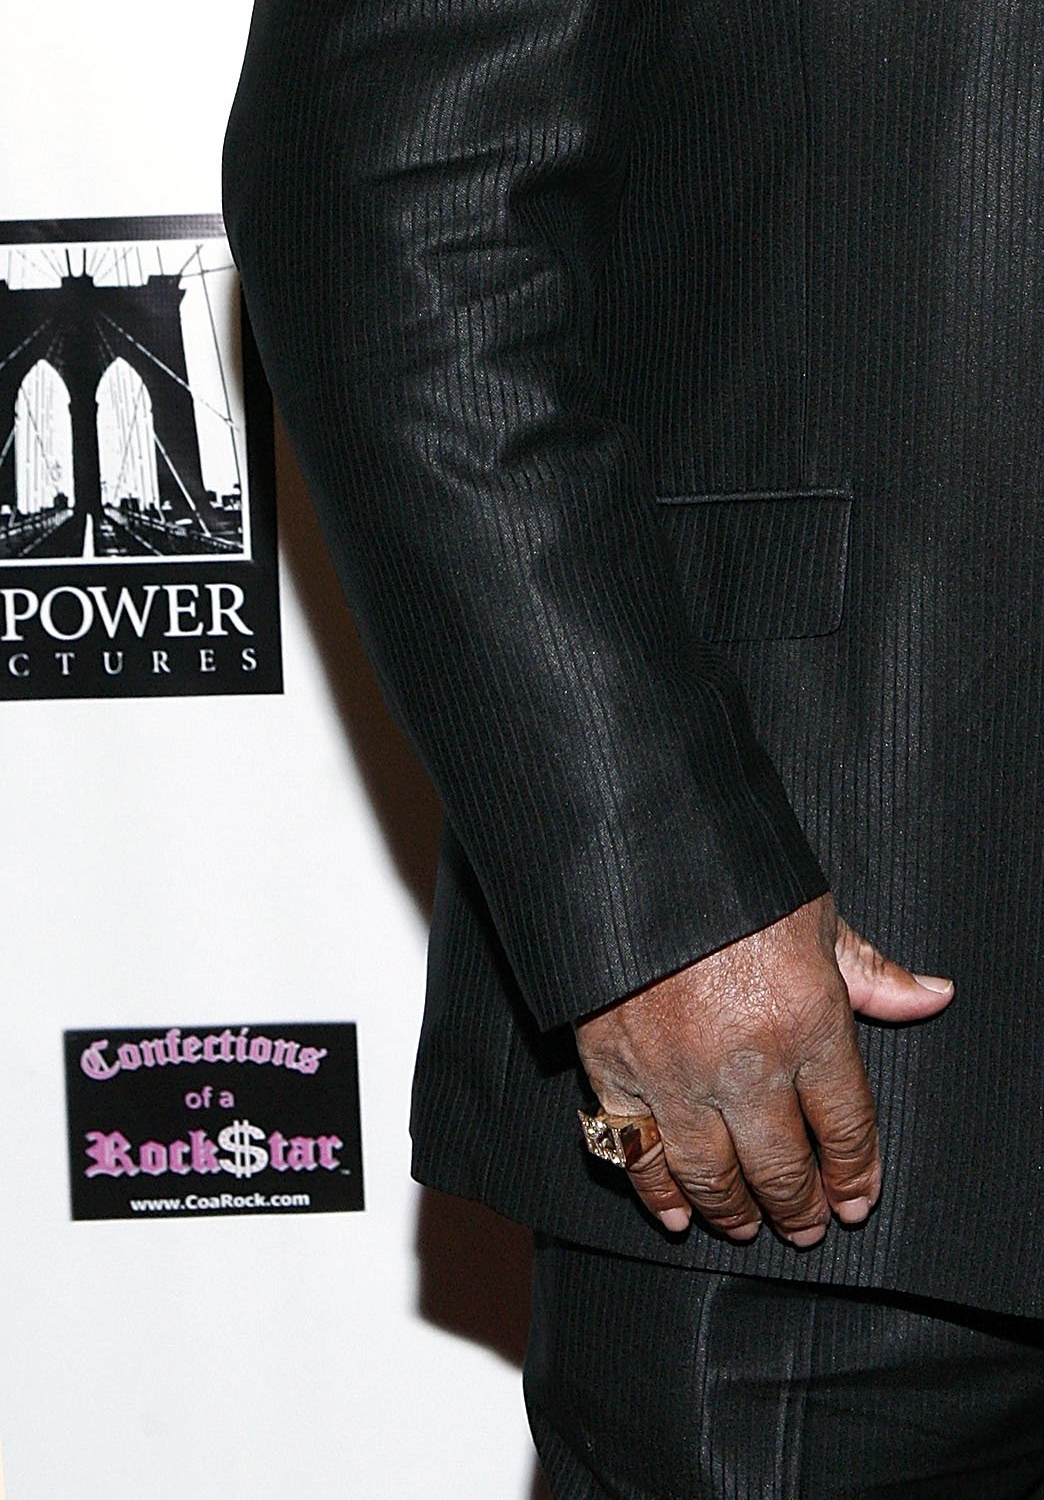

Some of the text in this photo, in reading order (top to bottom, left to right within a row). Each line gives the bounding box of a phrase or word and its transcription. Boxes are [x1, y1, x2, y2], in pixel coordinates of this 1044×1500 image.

[0, 583, 254, 641] POWER
[80, 1028, 328, 1080] Confections
[185, 1085, 235, 1109] of a
[130, 1192, 311, 1212] www.CoaRock.com
